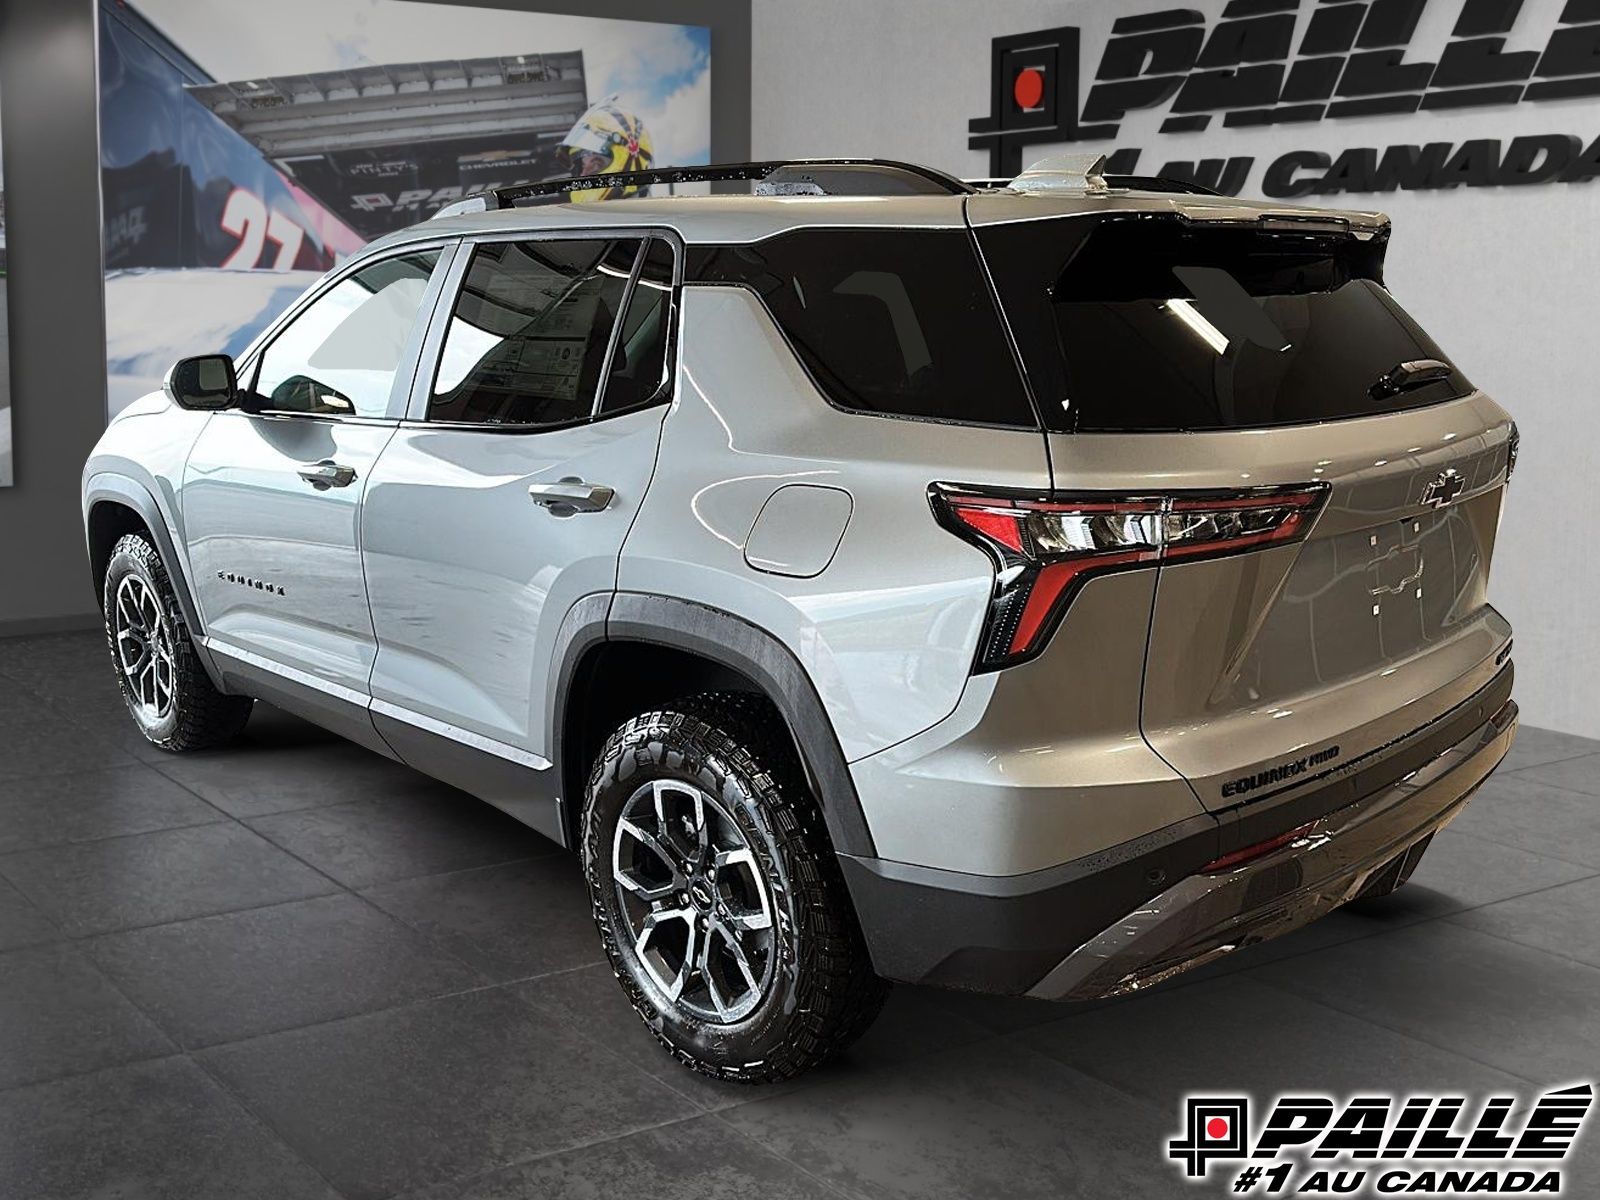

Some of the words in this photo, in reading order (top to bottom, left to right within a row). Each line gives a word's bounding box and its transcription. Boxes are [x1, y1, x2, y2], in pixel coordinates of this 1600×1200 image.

[459, 158, 537, 171] CHEVROLET
[221, 187, 304, 273] 27
[217, 570, 285, 597] EQUINOX
[1221, 757, 1308, 798] EQUINOX
